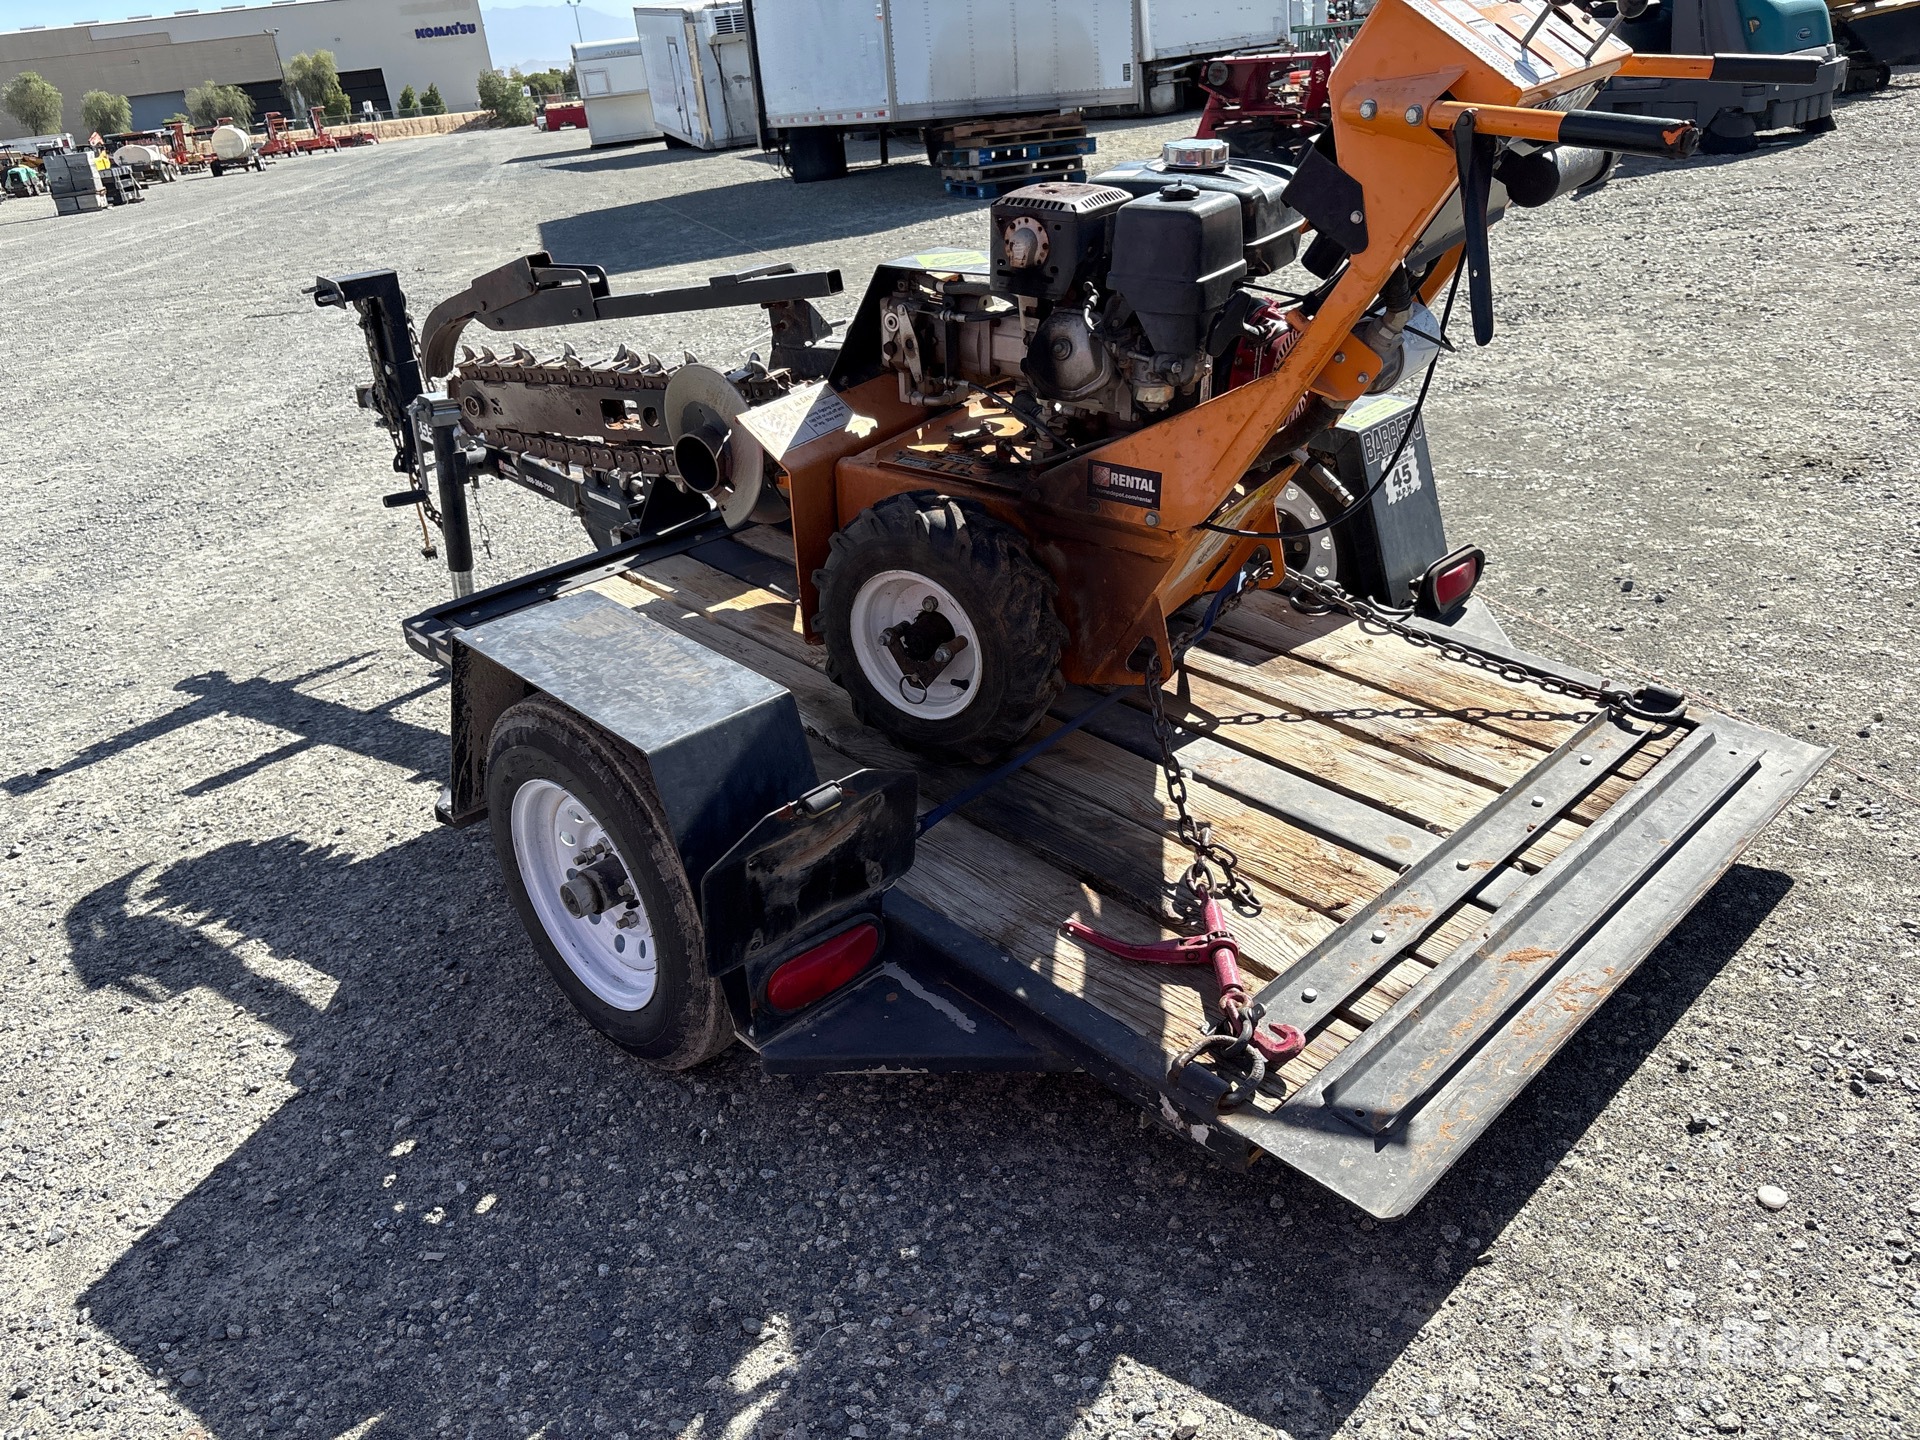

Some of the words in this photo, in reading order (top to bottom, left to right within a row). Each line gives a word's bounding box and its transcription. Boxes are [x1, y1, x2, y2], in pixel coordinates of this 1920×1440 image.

[415, 22, 476, 39] KOMATSU
[1362, 411, 1422, 465] BARRETO
[1111, 472, 1156, 493] RENTAL
[1392, 464, 1412, 488] 45
